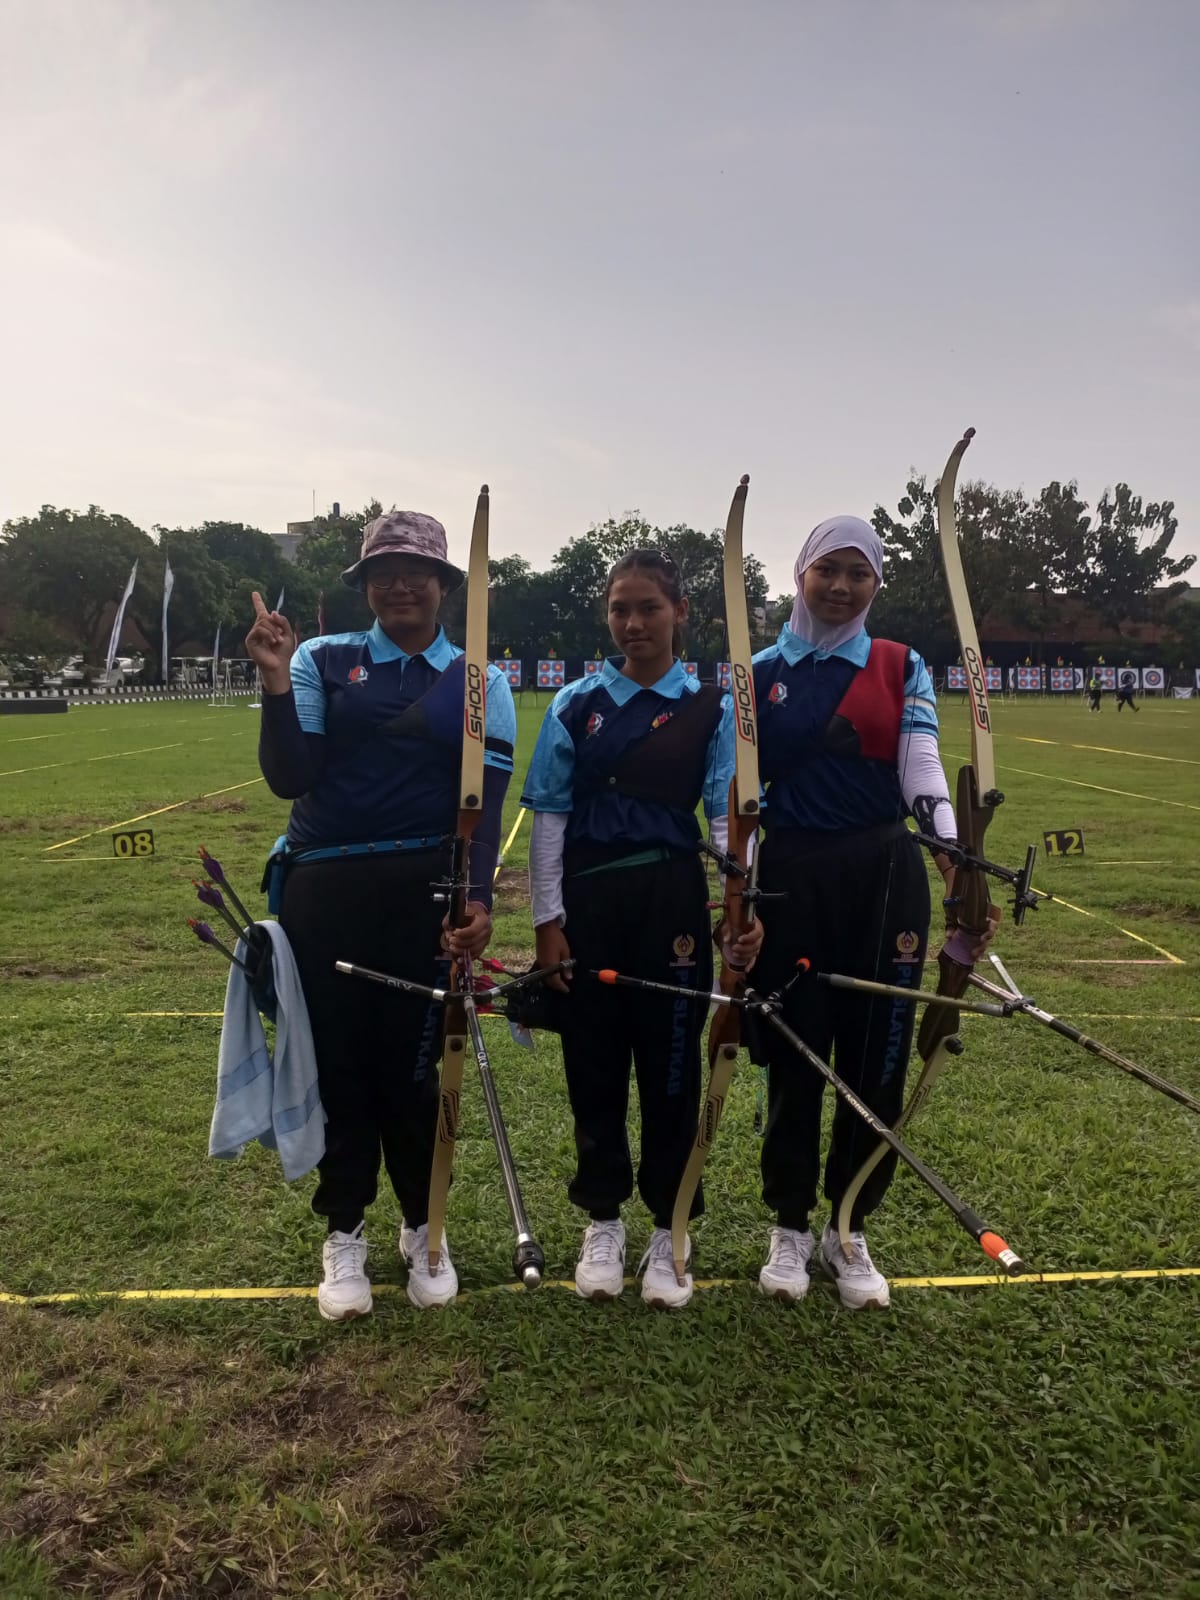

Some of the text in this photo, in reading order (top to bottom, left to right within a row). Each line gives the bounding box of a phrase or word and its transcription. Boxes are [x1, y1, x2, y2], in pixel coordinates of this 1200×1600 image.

[467, 663, 483, 743] SHOCO
[733, 663, 756, 746] SHOCO
[965, 646, 991, 734] SHOCO
[115, 832, 153, 856] 08
[1046, 832, 1082, 855] 12
[666, 968, 688, 1097] PSLATKAB
